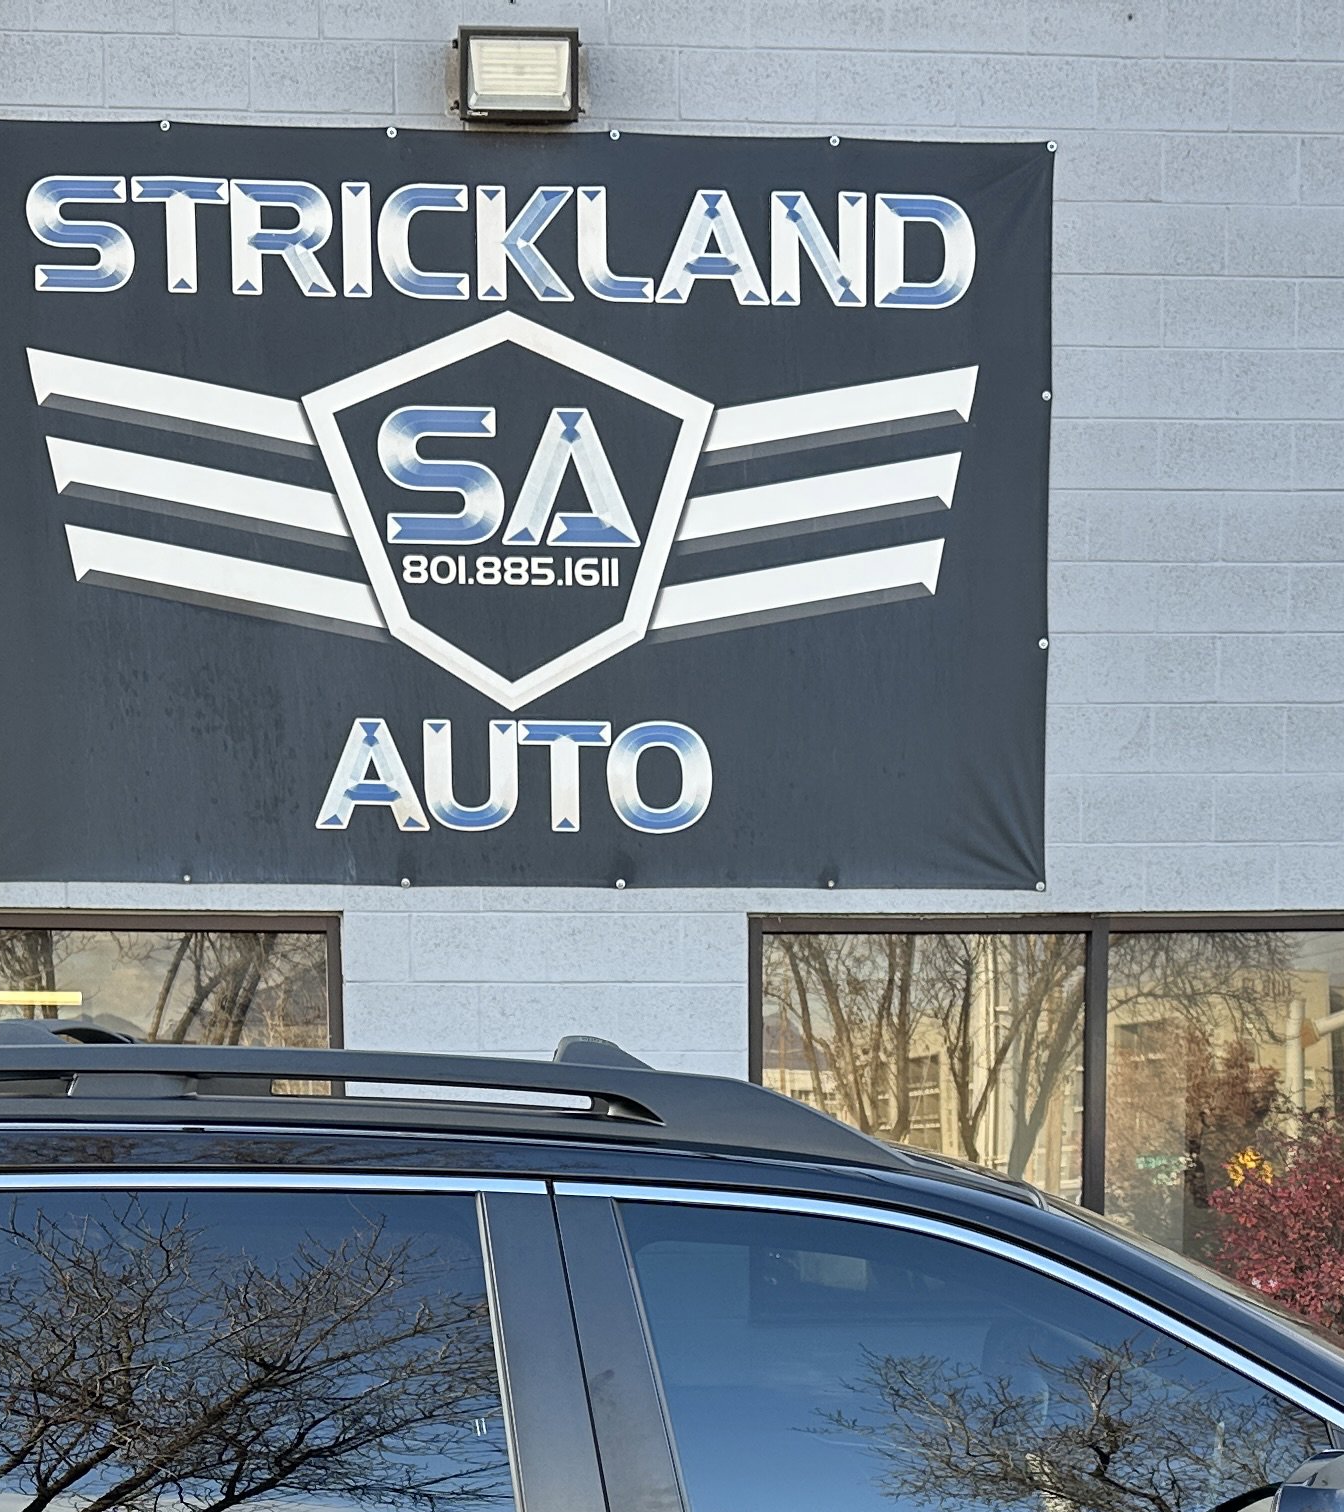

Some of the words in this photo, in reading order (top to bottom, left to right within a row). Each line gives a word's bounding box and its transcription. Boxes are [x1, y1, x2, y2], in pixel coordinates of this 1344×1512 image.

[26, 174, 977, 309] STRICKLAND
[377, 405, 642, 547] SA
[401, 555, 620, 588] 801.885.1611
[315, 718, 714, 833] AUTO
